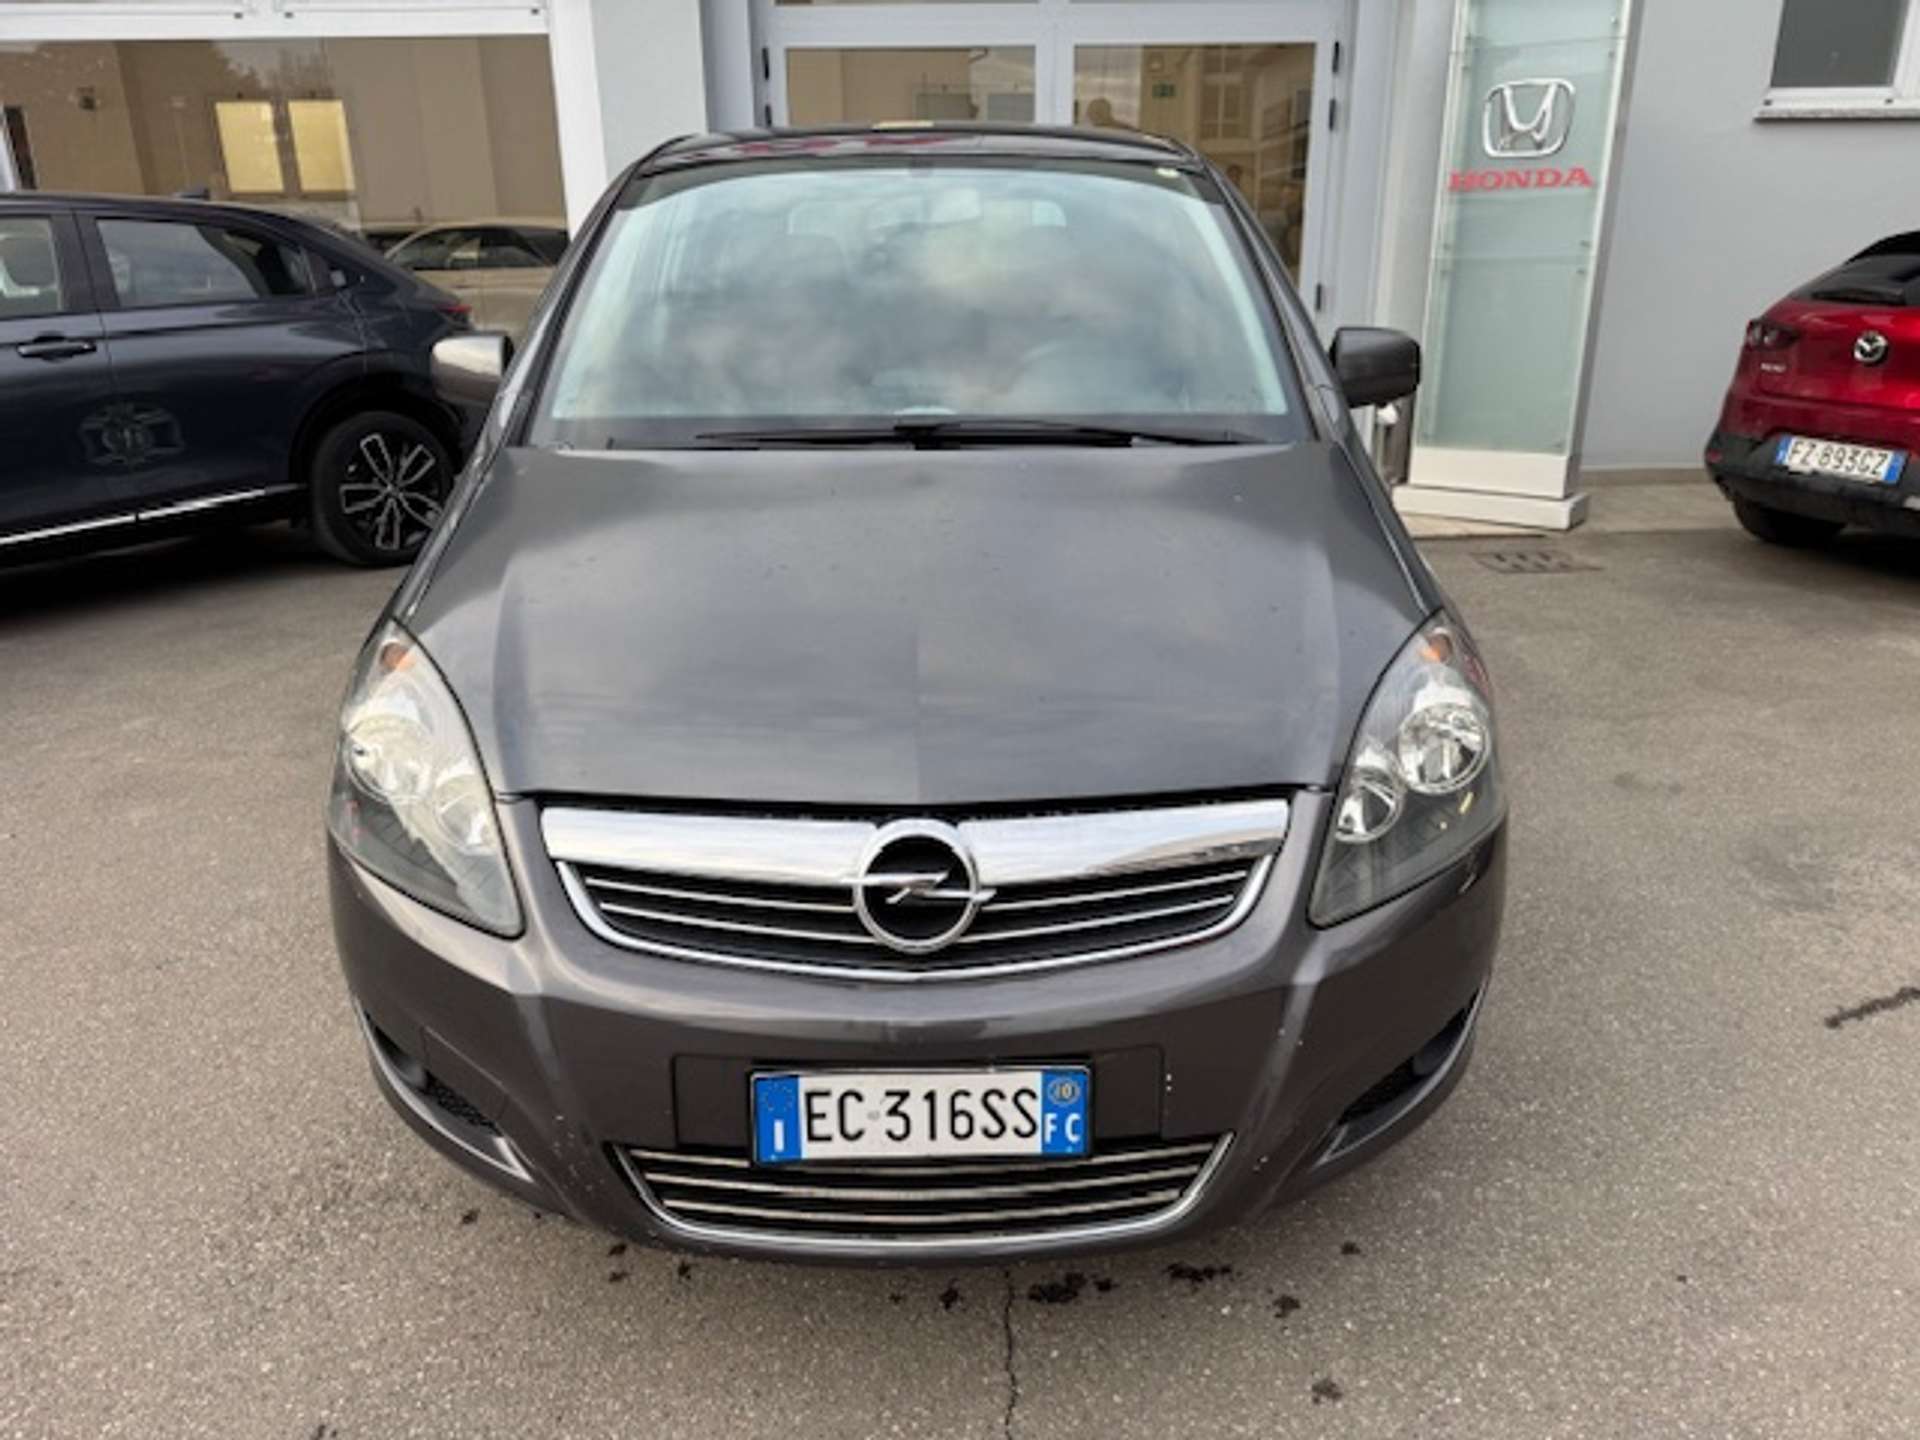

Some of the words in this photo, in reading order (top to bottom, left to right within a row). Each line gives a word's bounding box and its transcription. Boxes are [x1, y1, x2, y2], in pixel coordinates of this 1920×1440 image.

[1449, 167, 1593, 191] HONDA
[1789, 441, 1816, 465] FZ
[805, 1089, 865, 1142] EC
[884, 1088, 1038, 1142] 316SS
